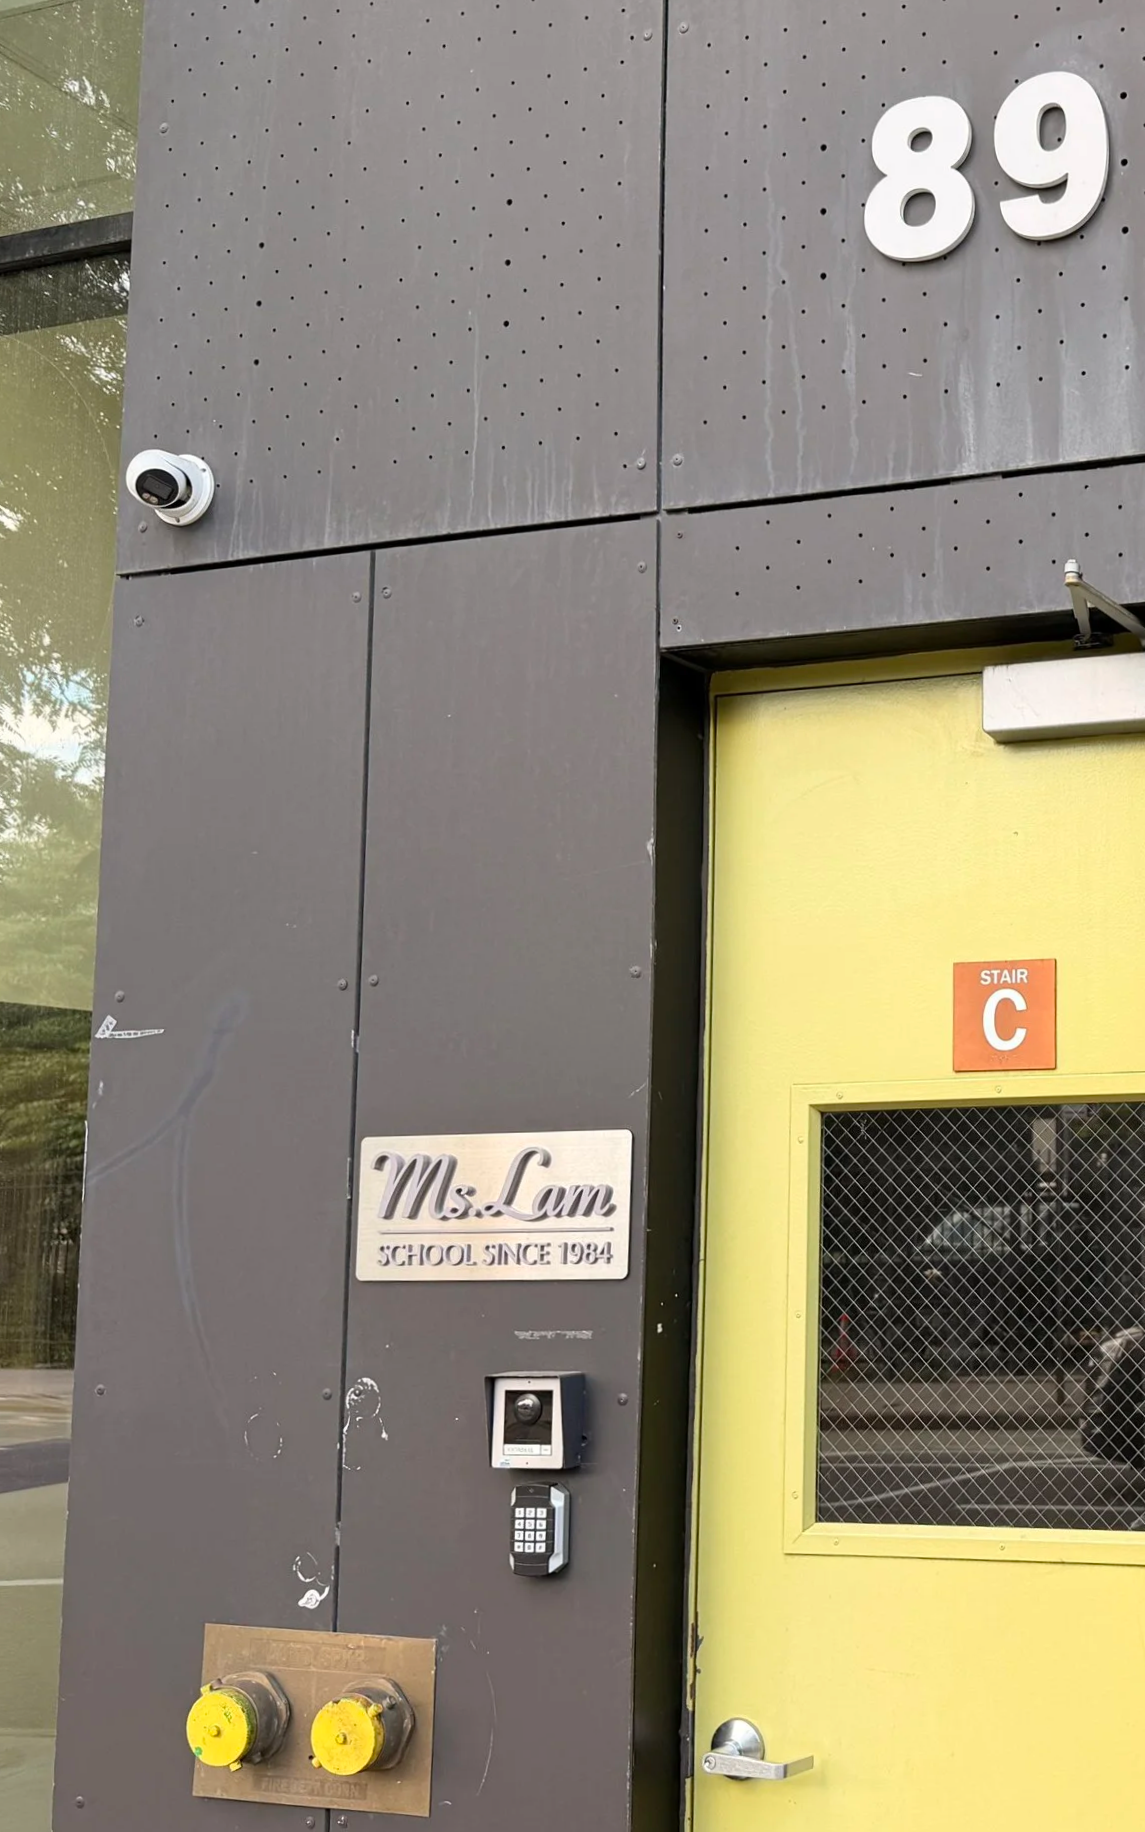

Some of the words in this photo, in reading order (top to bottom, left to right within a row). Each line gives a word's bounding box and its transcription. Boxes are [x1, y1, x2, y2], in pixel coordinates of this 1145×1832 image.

[864, 71, 1109, 263] 89
[980, 968, 1028, 985] STAIR
[982, 987, 1028, 1051] C
[377, 1242, 478, 1267] SCHOOL
[482, 1241, 552, 1266] SINCE
[557, 1240, 614, 1265] 1984
